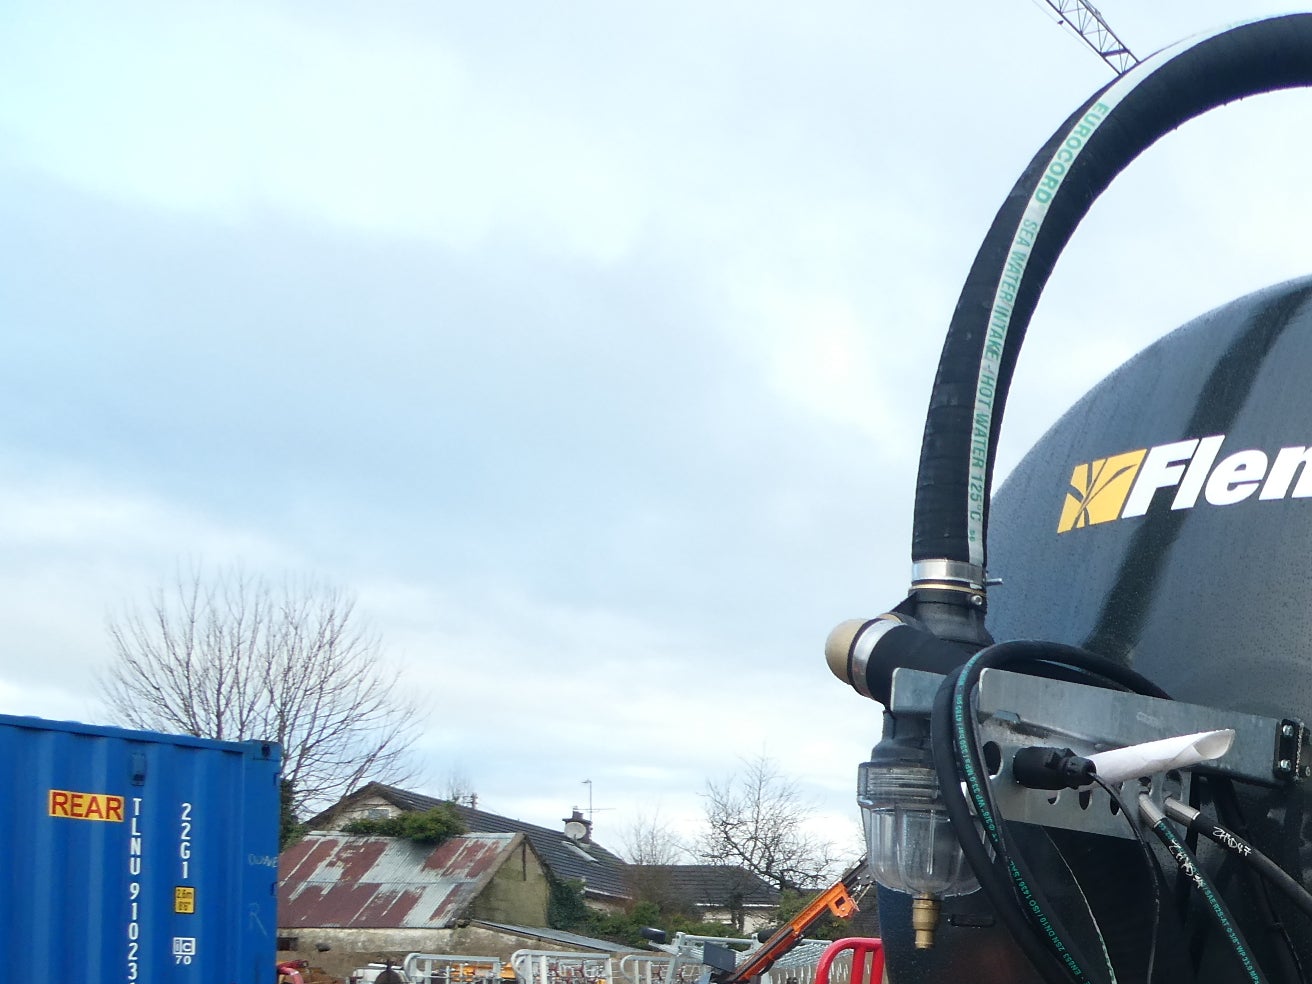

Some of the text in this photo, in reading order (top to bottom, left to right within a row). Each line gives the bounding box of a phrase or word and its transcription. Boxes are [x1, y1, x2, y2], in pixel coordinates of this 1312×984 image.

[1035, 102, 1110, 203] EUROCORD
[1015, 219, 1038, 247] SEA
[999, 251, 1027, 302] WATER
[985, 305, 1009, 360] INTAKE
[978, 374, 995, 409] HOT
[971, 413, 988, 469] WATER
[52, 792, 123, 820] REAR
[976, 794, 985, 807] WP
[129, 797, 143, 876] TLNU
[181, 803, 192, 879] 22G1
[175, 956, 192, 965] 70
[1236, 945, 1246, 956] WP
